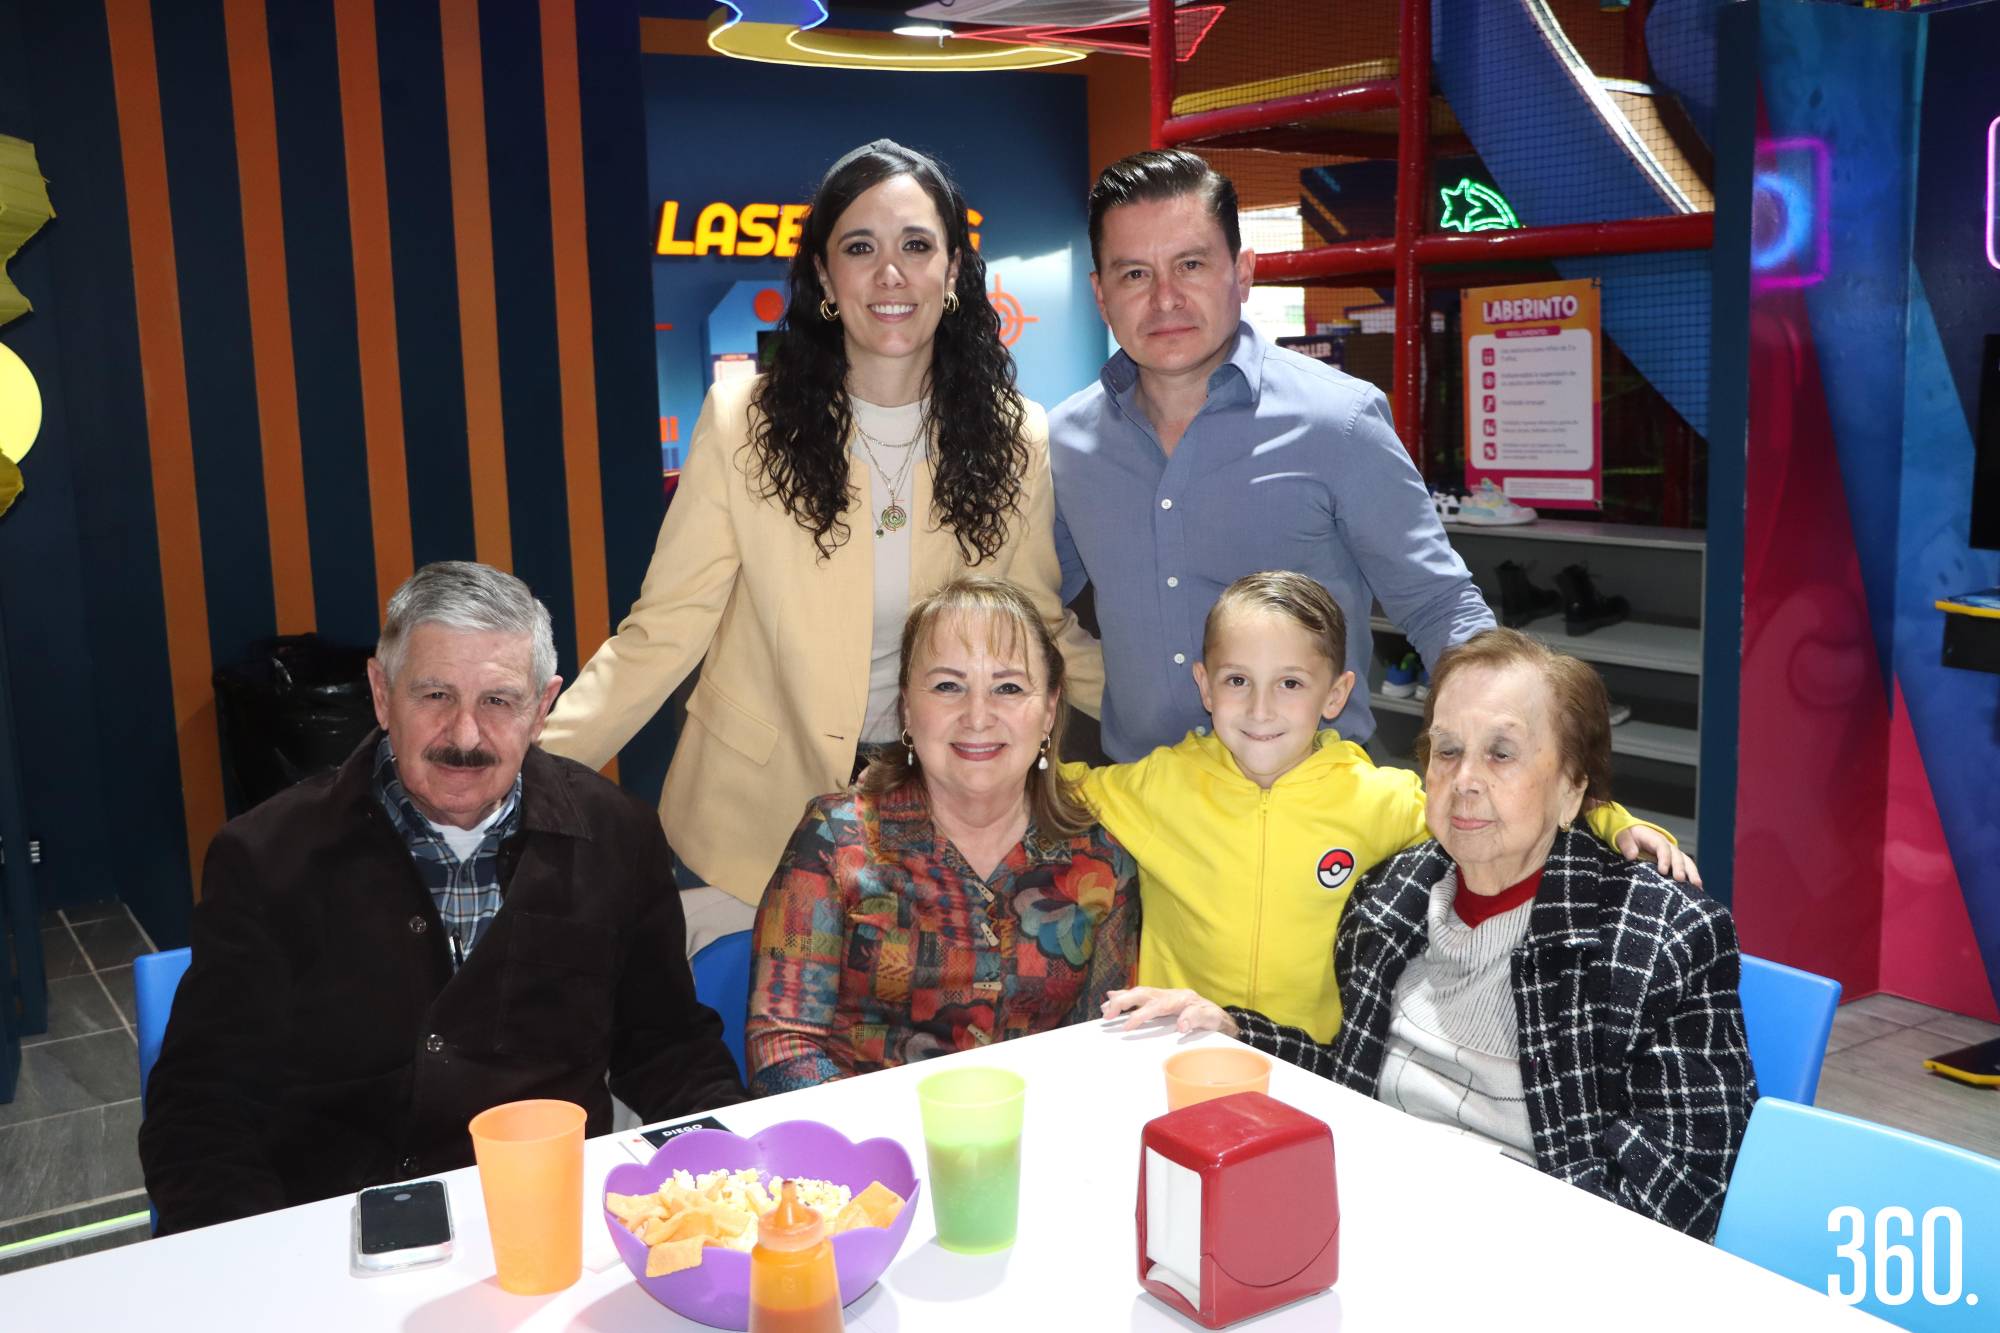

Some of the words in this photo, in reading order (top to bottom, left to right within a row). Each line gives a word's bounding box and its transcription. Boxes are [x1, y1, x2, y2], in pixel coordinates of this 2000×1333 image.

[657, 200, 812, 257] LASE
[1482, 295, 1578, 323] LABERINTO
[662, 1123, 703, 1137] DIEGO
